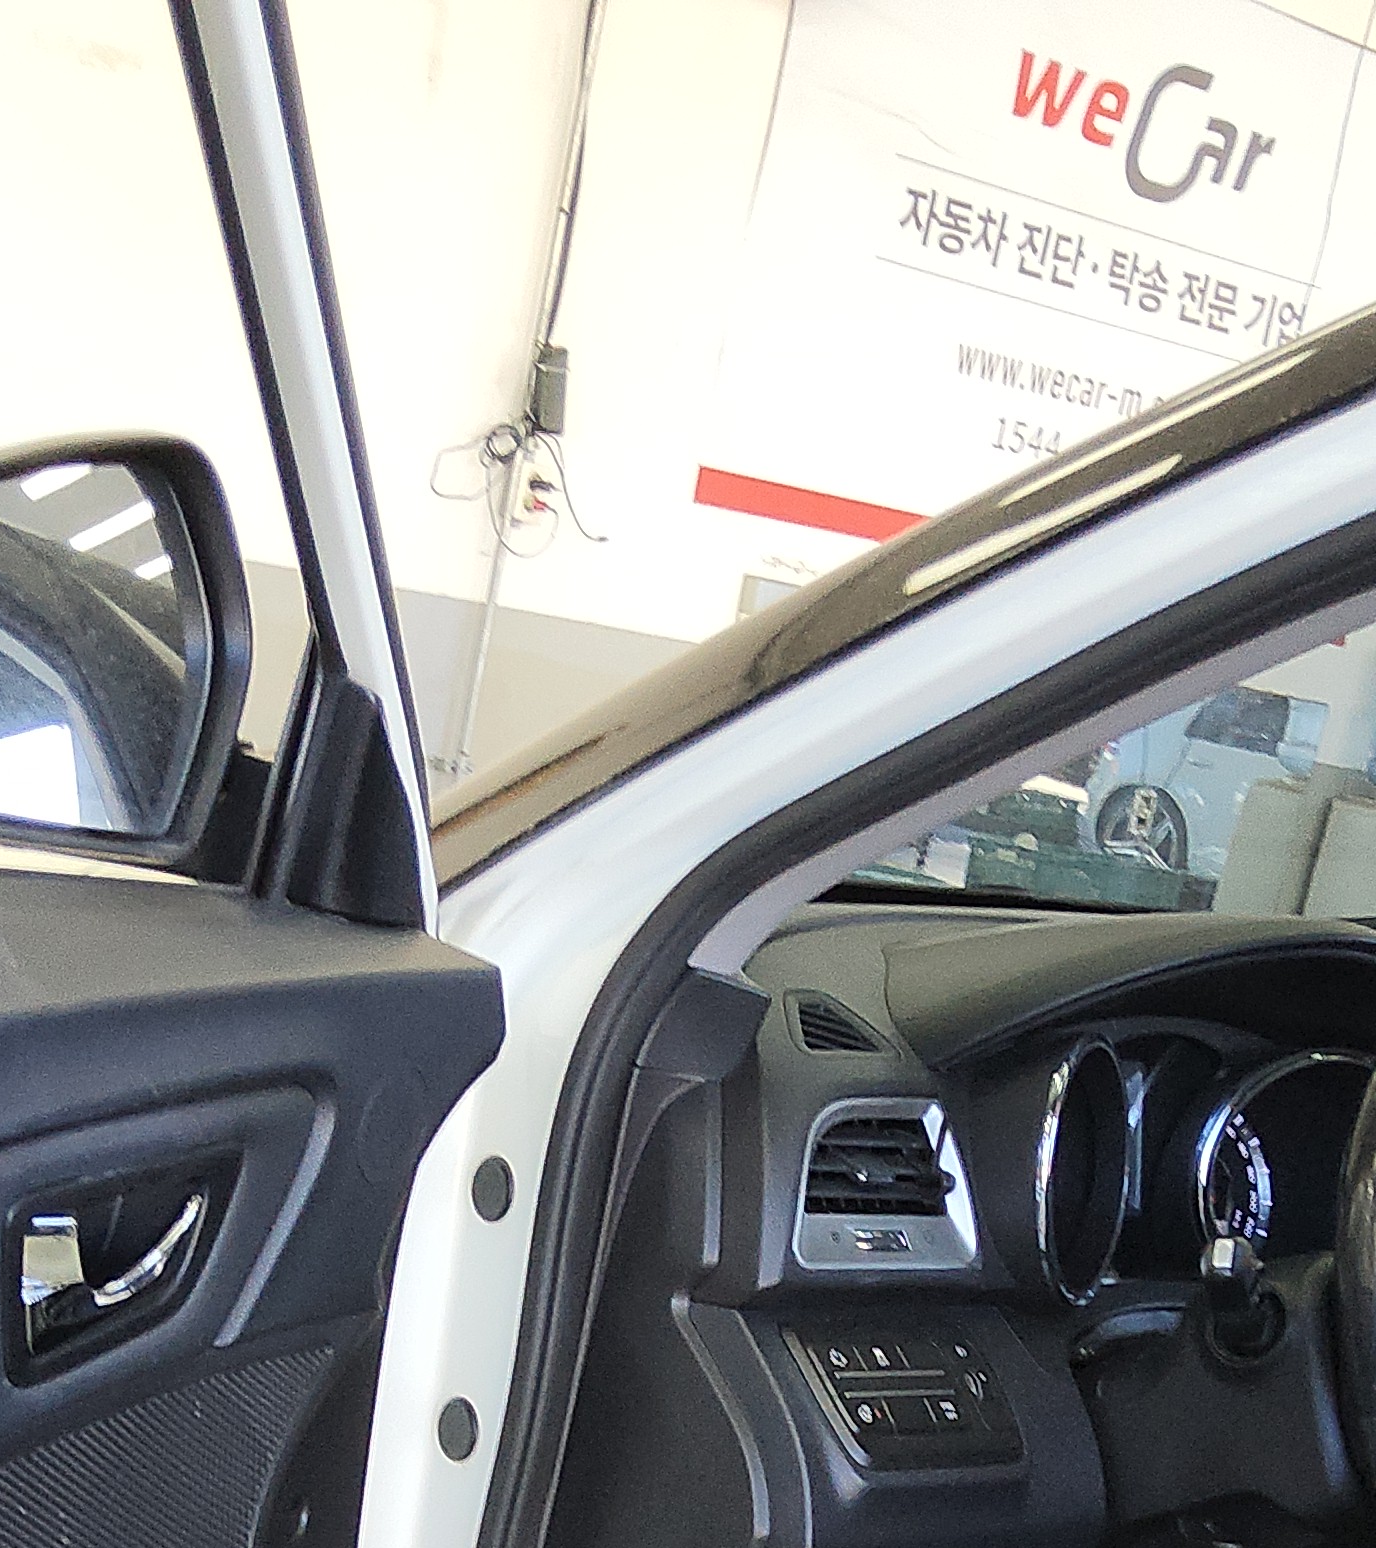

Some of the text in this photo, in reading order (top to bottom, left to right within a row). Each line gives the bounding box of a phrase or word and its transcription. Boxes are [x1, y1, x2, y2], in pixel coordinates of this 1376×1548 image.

[899, 187, 1009, 268] 자동차
[1177, 271, 1239, 334] 전문
[1243, 292, 1307, 348] 기업
